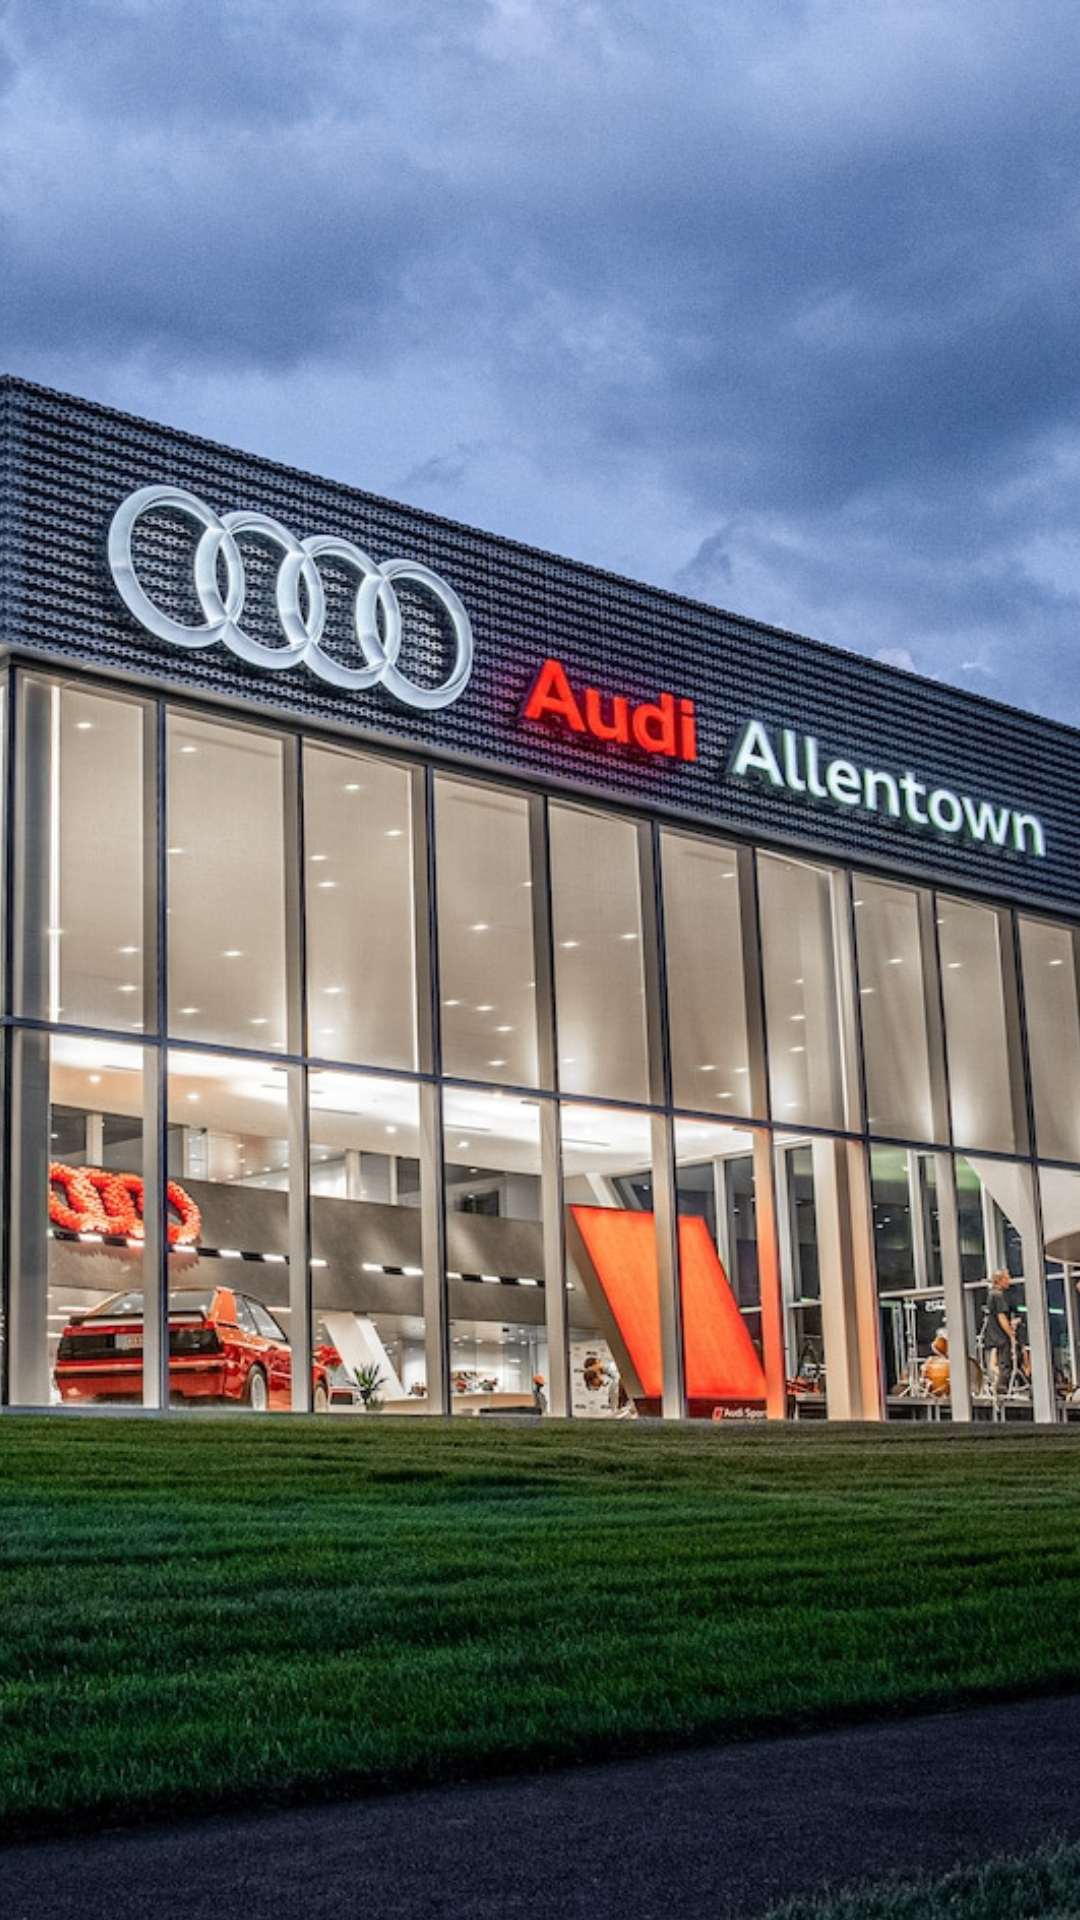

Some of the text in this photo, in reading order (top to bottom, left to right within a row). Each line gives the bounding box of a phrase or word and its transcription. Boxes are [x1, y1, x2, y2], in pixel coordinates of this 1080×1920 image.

[523, 659, 1046, 857] Audi Allentown
[724, 1407, 767, 1420] Audi Spor
